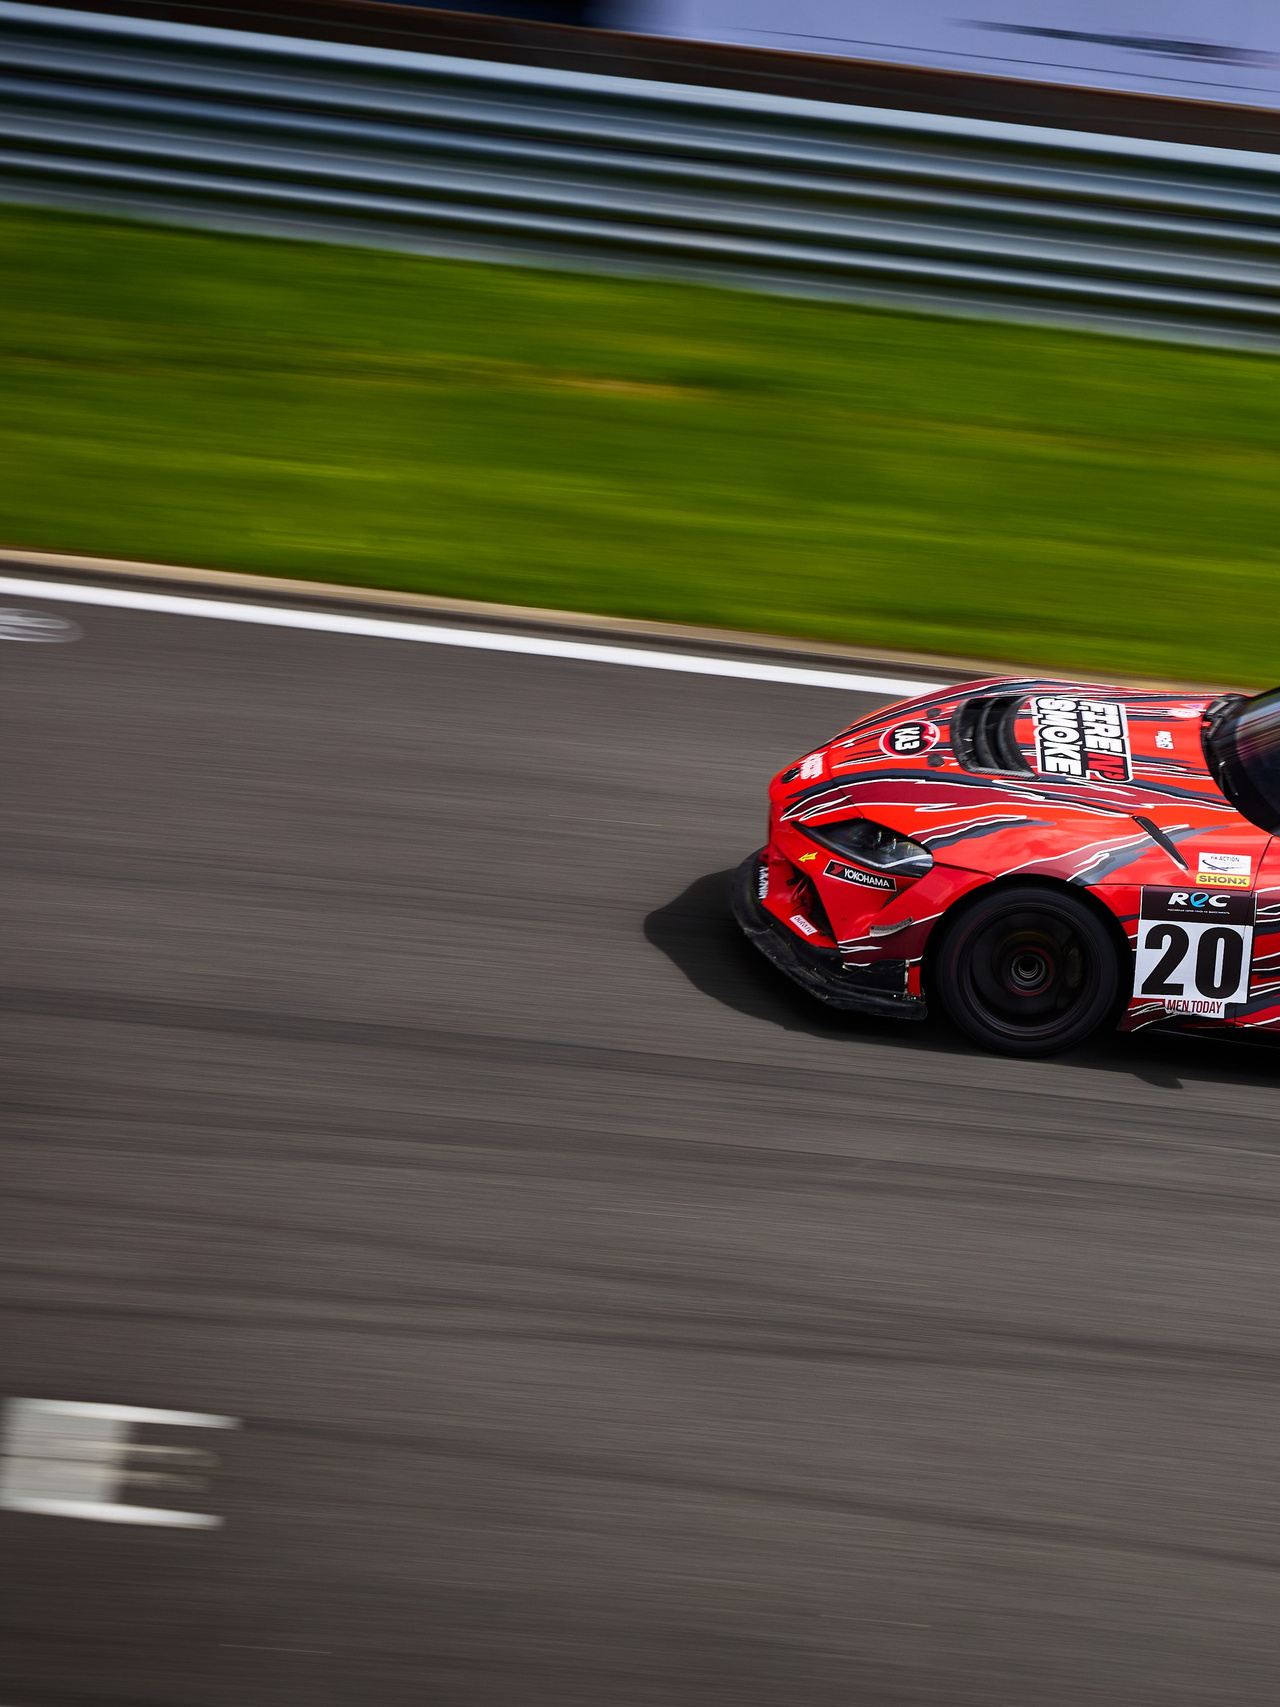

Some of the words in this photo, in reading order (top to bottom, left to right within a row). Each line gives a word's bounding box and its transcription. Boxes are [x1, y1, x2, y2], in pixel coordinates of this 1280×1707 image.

[1036, 696, 1083, 777] SMOKE
[1083, 699, 1123, 756] FIRE
[844, 868, 890, 888] YOKOHAMA
[1198, 874, 1248, 886] SHONX
[1141, 923, 1244, 999] 20
[1166, 999, 1190, 1012] MEN
[1191, 1001, 1223, 1014] TODAY
